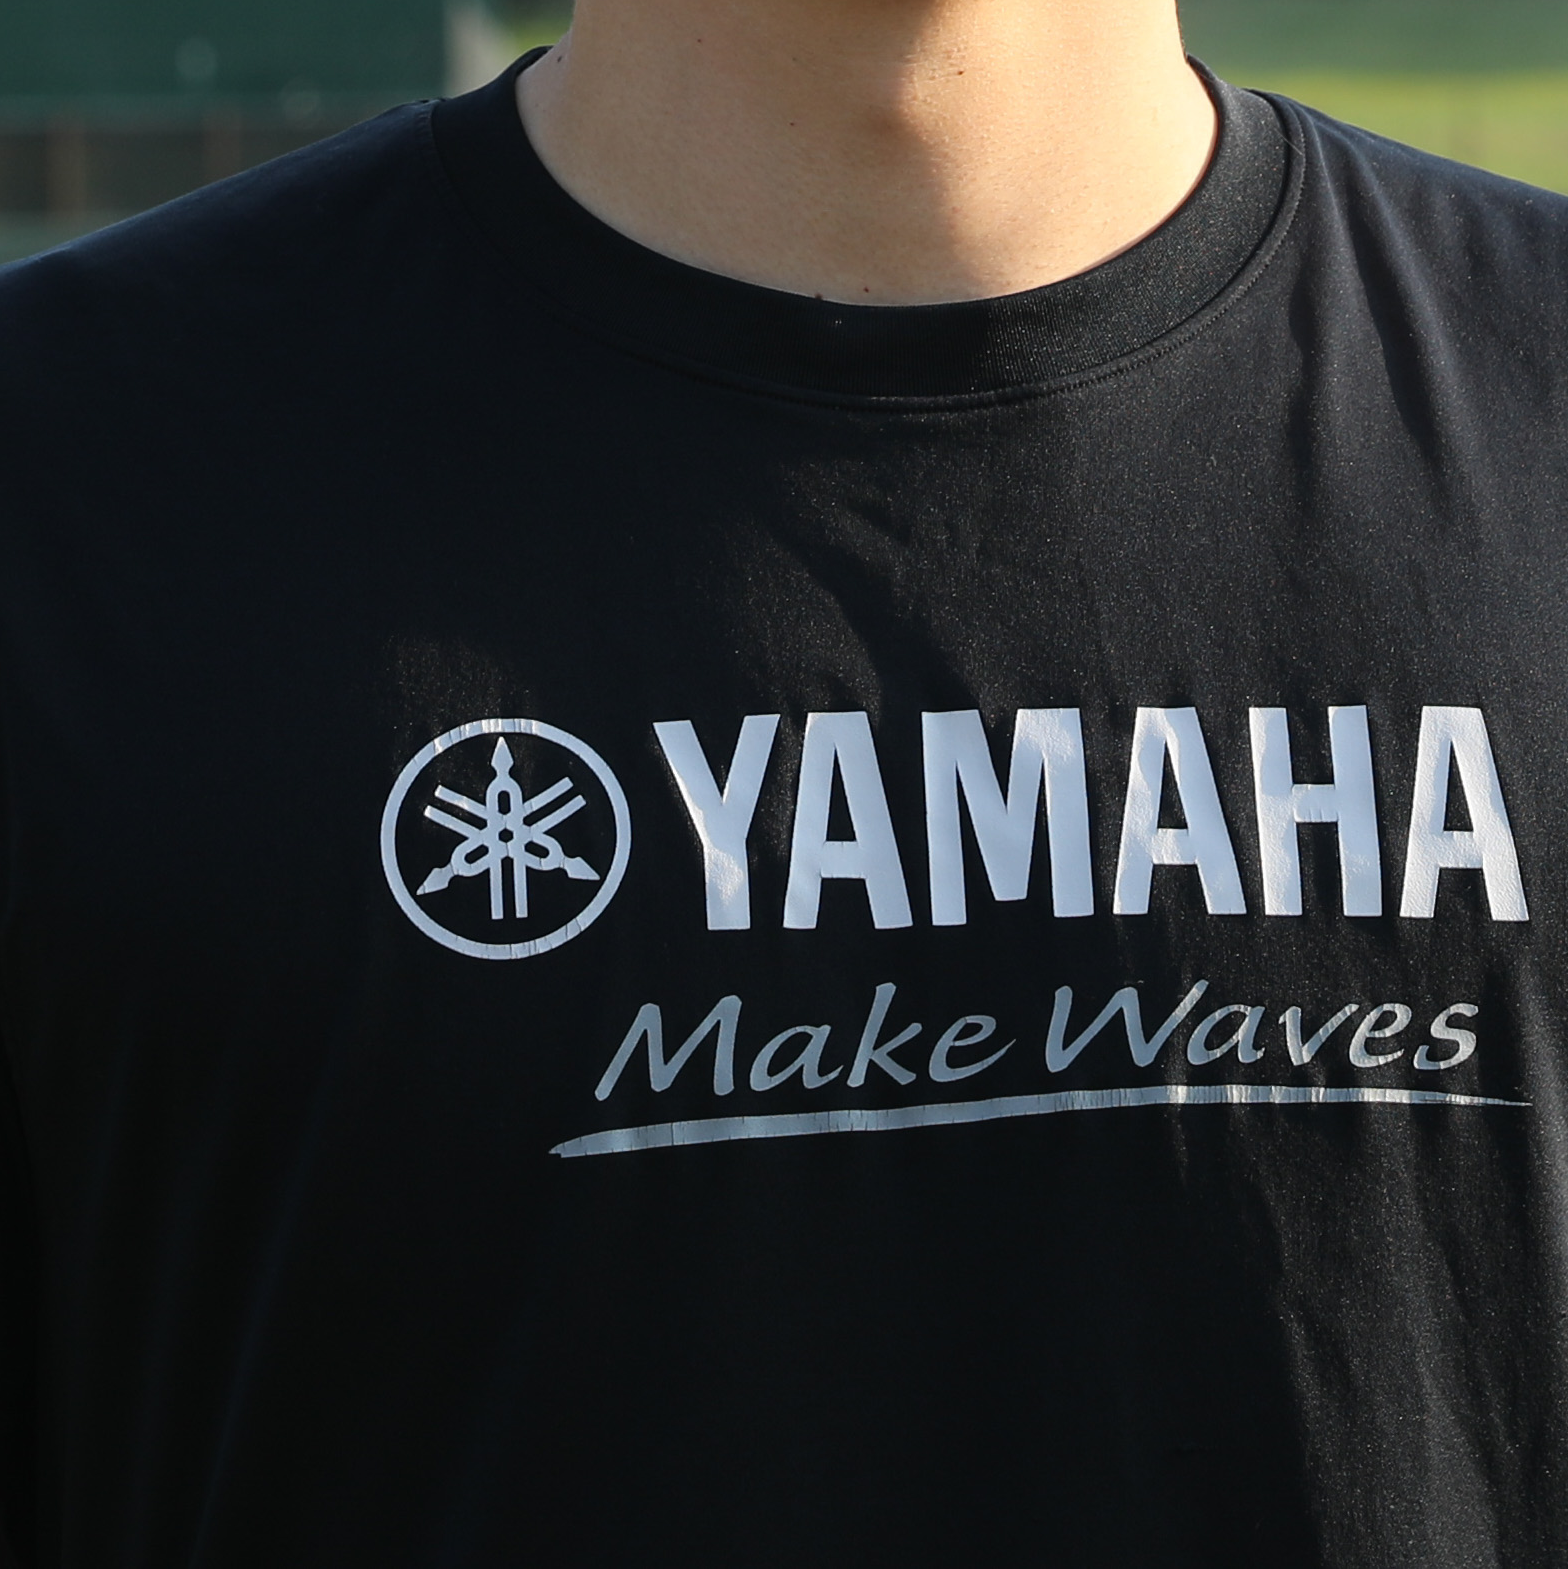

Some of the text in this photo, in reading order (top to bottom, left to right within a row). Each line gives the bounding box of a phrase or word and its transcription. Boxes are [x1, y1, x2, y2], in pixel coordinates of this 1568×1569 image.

[653, 703, 1530, 932] YAMAHA
[593, 978, 1479, 1101] Make Waves
